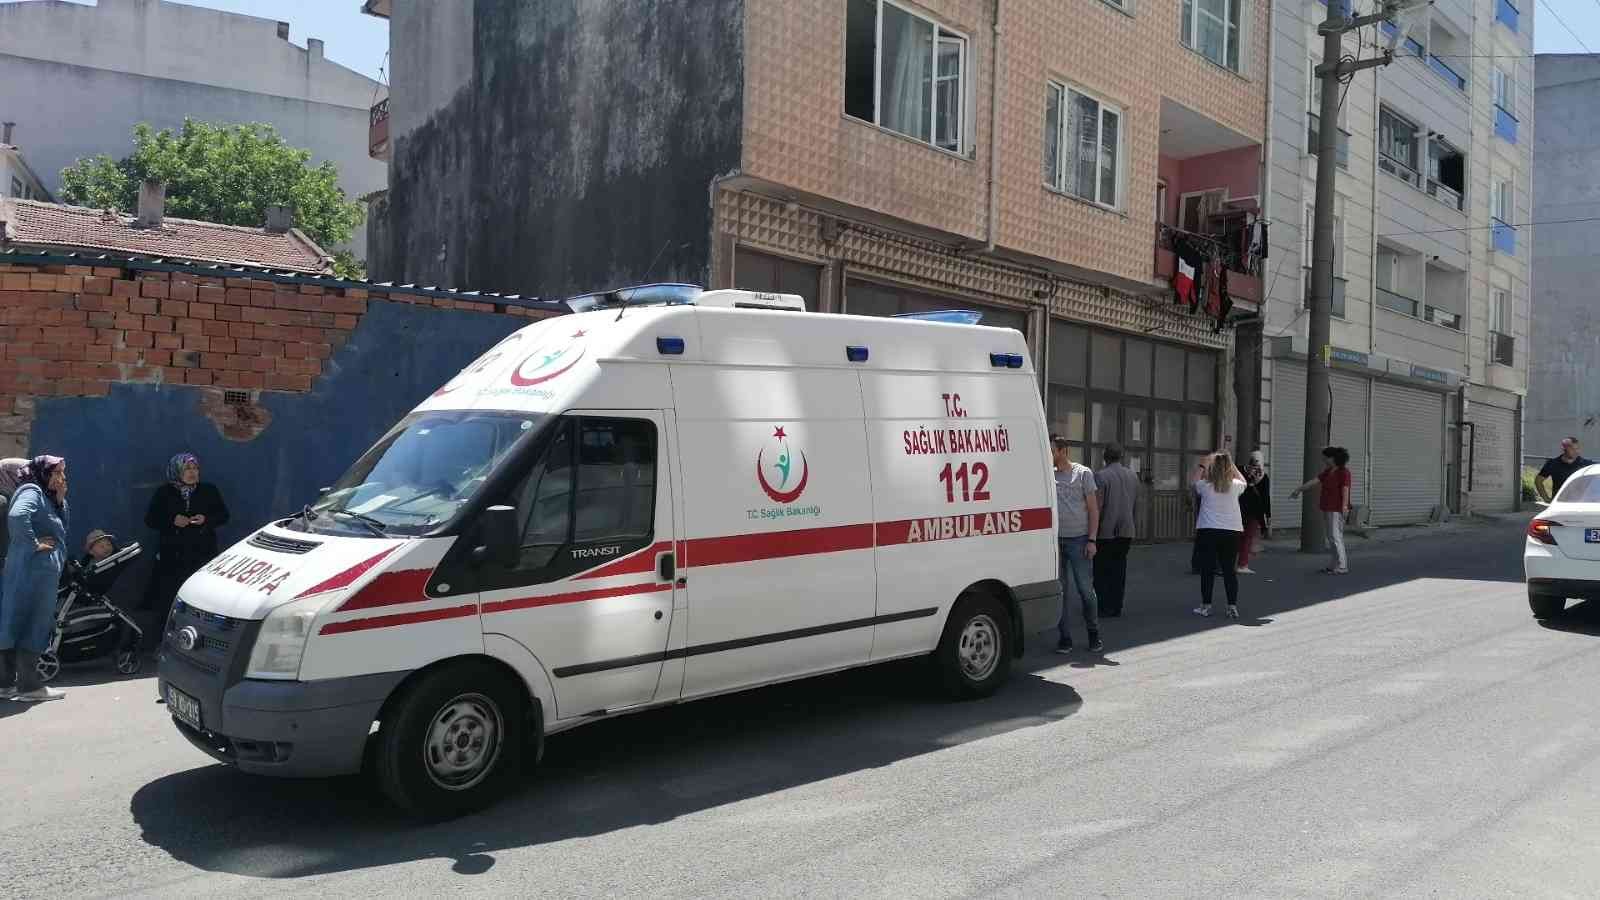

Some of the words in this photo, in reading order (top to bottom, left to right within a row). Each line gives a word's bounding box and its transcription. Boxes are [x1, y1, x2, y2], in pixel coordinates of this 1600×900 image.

[942, 393, 967, 418] T.C.
[904, 424, 947, 455] SAĞLIK
[950, 424, 1010, 454] BAKANLIĞI
[939, 462, 991, 503] 112
[907, 511, 1023, 543] AMBULANS
[571, 545, 622, 559] TRANSIT
